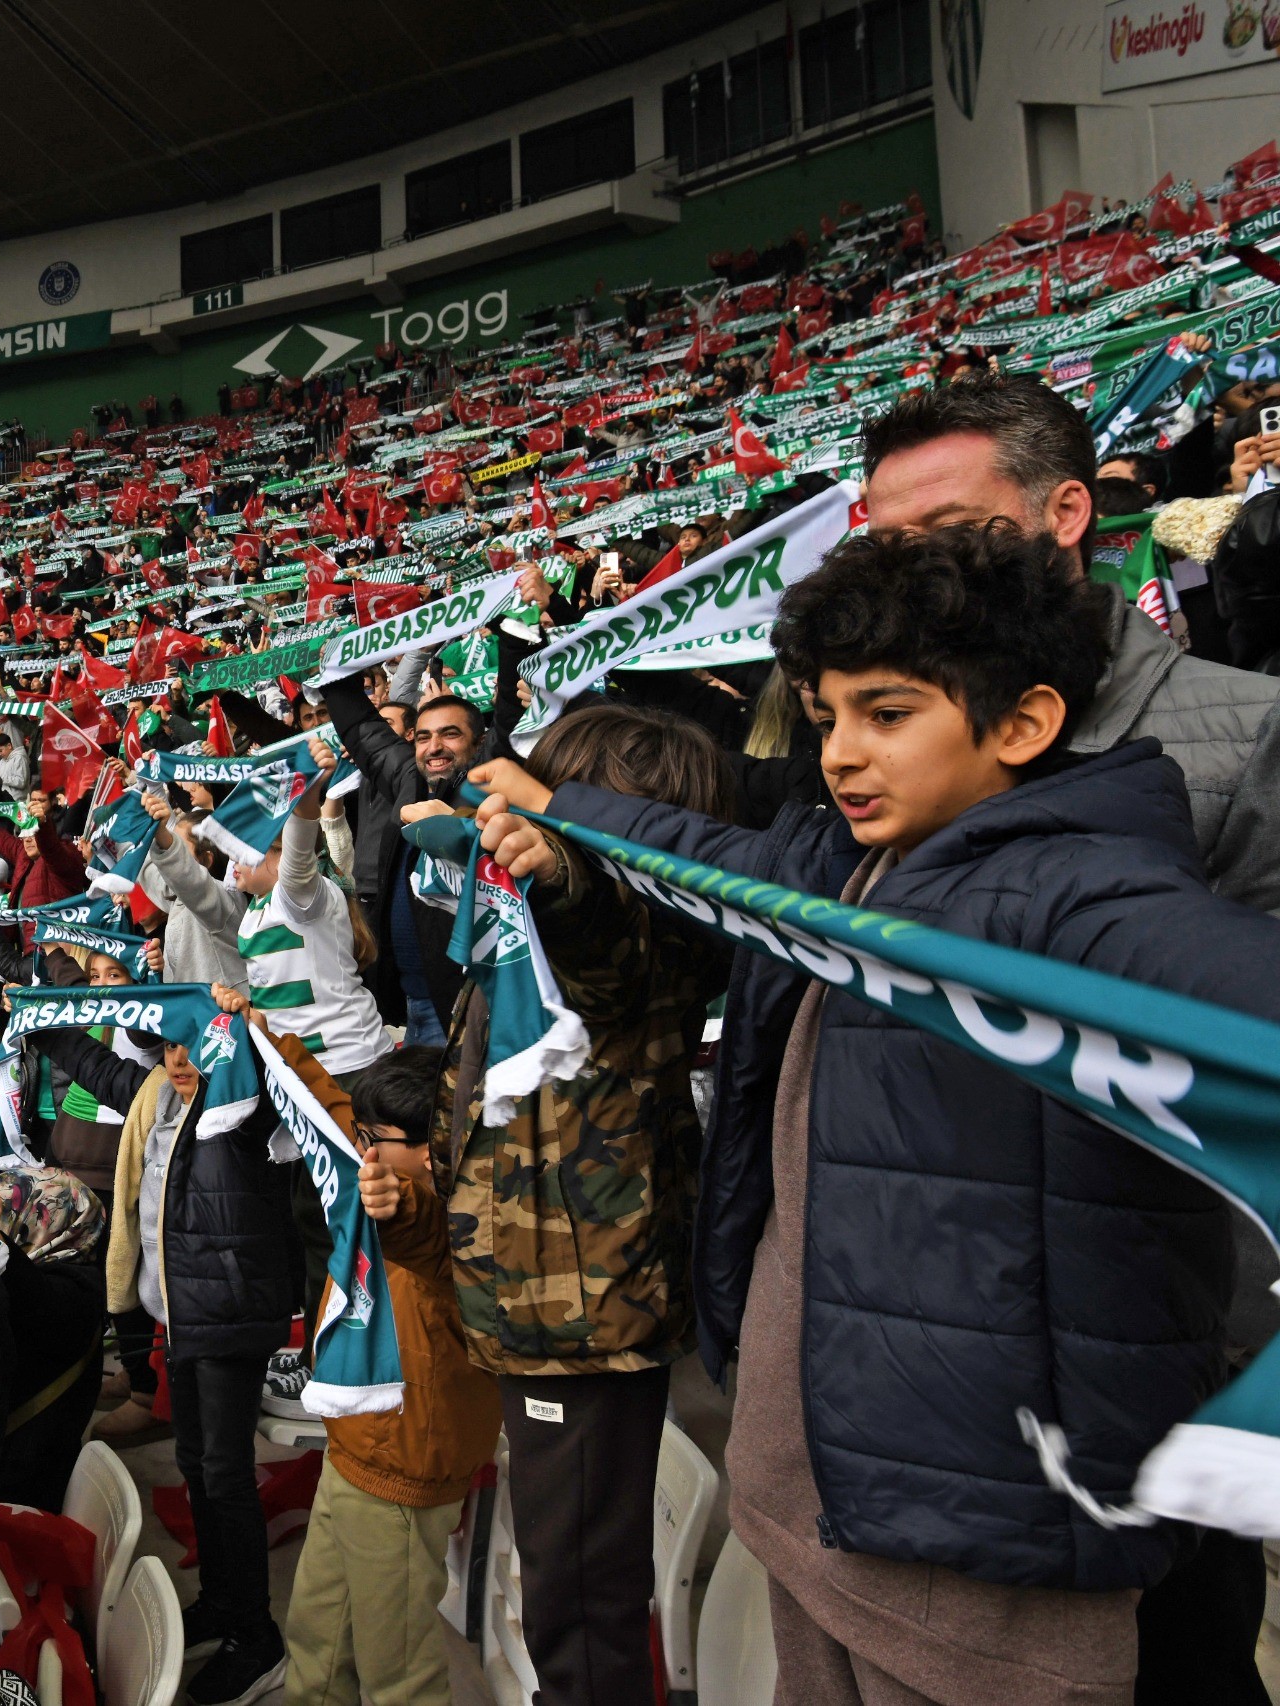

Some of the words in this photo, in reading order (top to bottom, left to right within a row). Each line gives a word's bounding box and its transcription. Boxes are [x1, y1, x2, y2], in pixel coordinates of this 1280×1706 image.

[1126, 3, 1205, 58] keskinoğlu
[204, 290, 232, 311] 111
[371, 288, 508, 346] Togg
[339, 589, 485, 666] BURSASPOR
[545, 537, 786, 692] BURSASPOR
[43, 924, 127, 960] BURSASPOR
